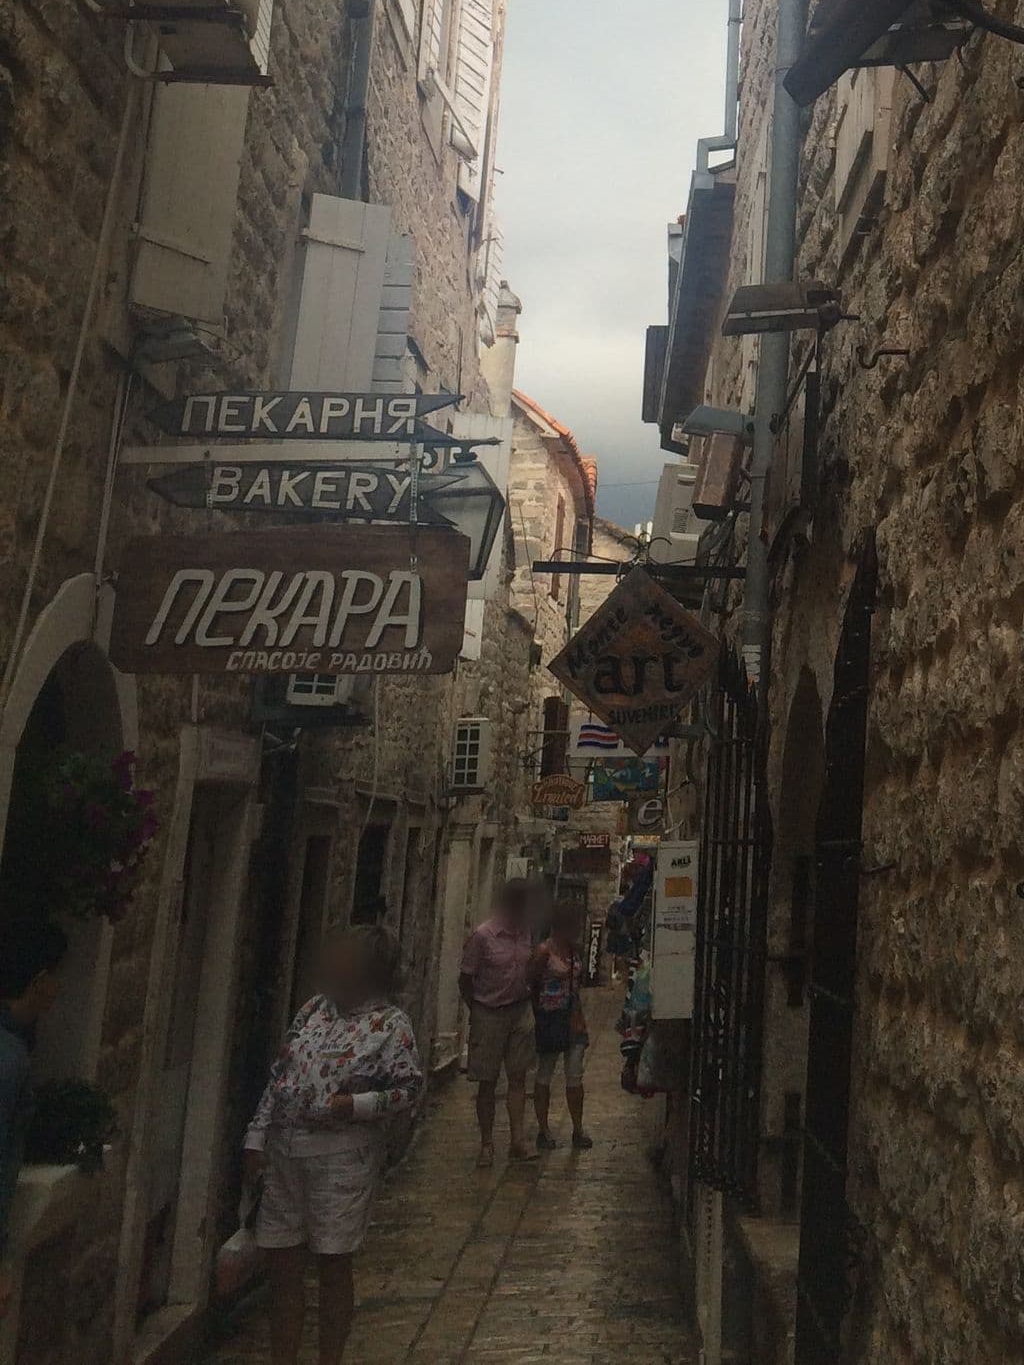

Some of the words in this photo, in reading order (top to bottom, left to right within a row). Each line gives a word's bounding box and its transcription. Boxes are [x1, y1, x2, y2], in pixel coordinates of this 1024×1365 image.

[180, 395, 417, 435] ПЕКАРНЯ
[209, 466, 413, 514] BAKERY
[145, 568, 423, 648] ПЕКАРА
[594, 652, 687, 696] art
[579, 834, 609, 845] MARKET
